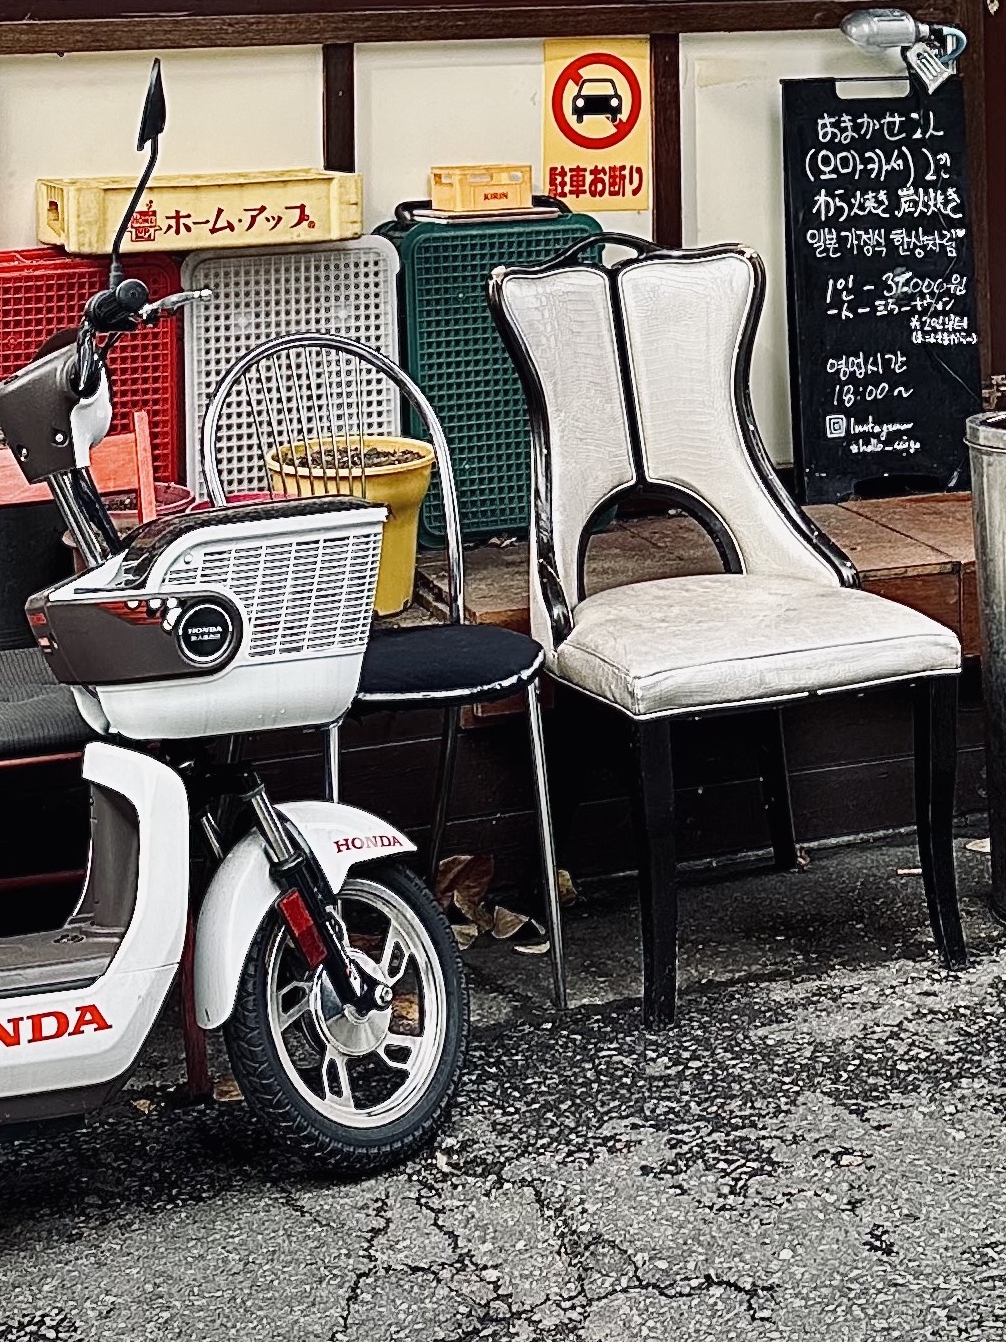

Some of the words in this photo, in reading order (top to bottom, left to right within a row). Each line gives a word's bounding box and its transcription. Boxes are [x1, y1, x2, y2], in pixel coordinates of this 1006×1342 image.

[548, 164, 644, 199] 駐車お断り
[806, 227, 842, 258] 일본
[334, 834, 404, 854] HONDA
